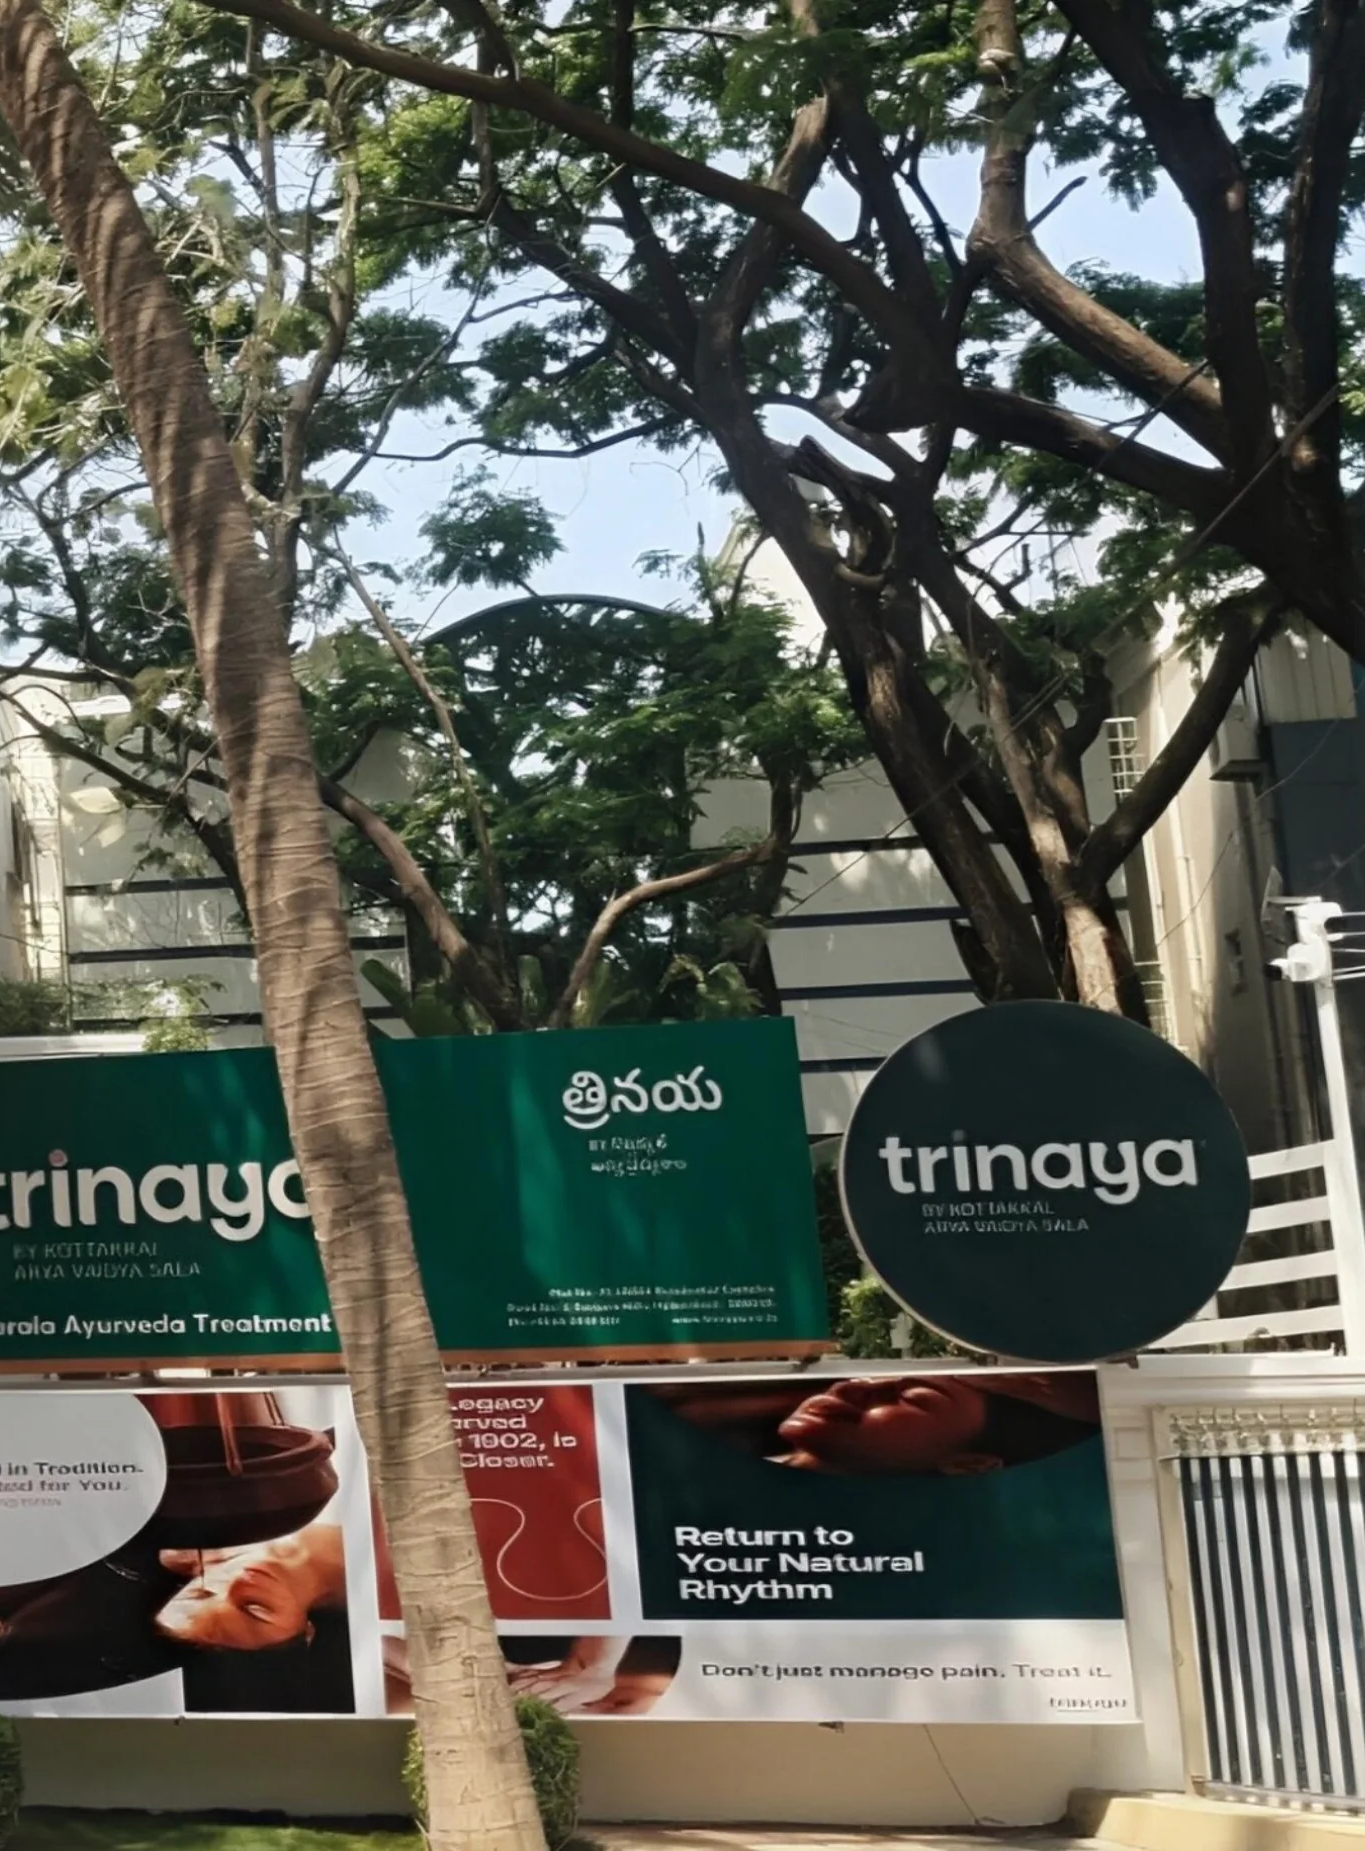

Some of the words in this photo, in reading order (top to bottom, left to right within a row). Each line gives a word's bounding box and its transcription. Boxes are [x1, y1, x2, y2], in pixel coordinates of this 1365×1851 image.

[562, 1065, 723, 1130] త్రినయ
[879, 1130, 1198, 1205] trinaya
[64, 1314, 186, 1340] Ayurveda
[193, 1313, 332, 1333] Treatment
[450, 1397, 544, 1414] egacy
[468, 1432, 546, 1451] 1902,
[8, 1462, 28, 1477] in
[35, 1461, 144, 1477] Tradition.
[459, 1453, 554, 1468] Closer.
[40, 1479, 69, 1492] for
[674, 1526, 806, 1548] Return
[814, 1525, 854, 1547] to
[676, 1552, 770, 1574] Your
[779, 1551, 925, 1574] Natural
[678, 1578, 833, 1605] Rhythm
[701, 1663, 771, 1678] Don't
[775, 1662, 823, 1681] just
[829, 1664, 934, 1681] manage
[941, 1663, 1006, 1681] pain.
[1011, 1663, 1080, 1679] Treat
